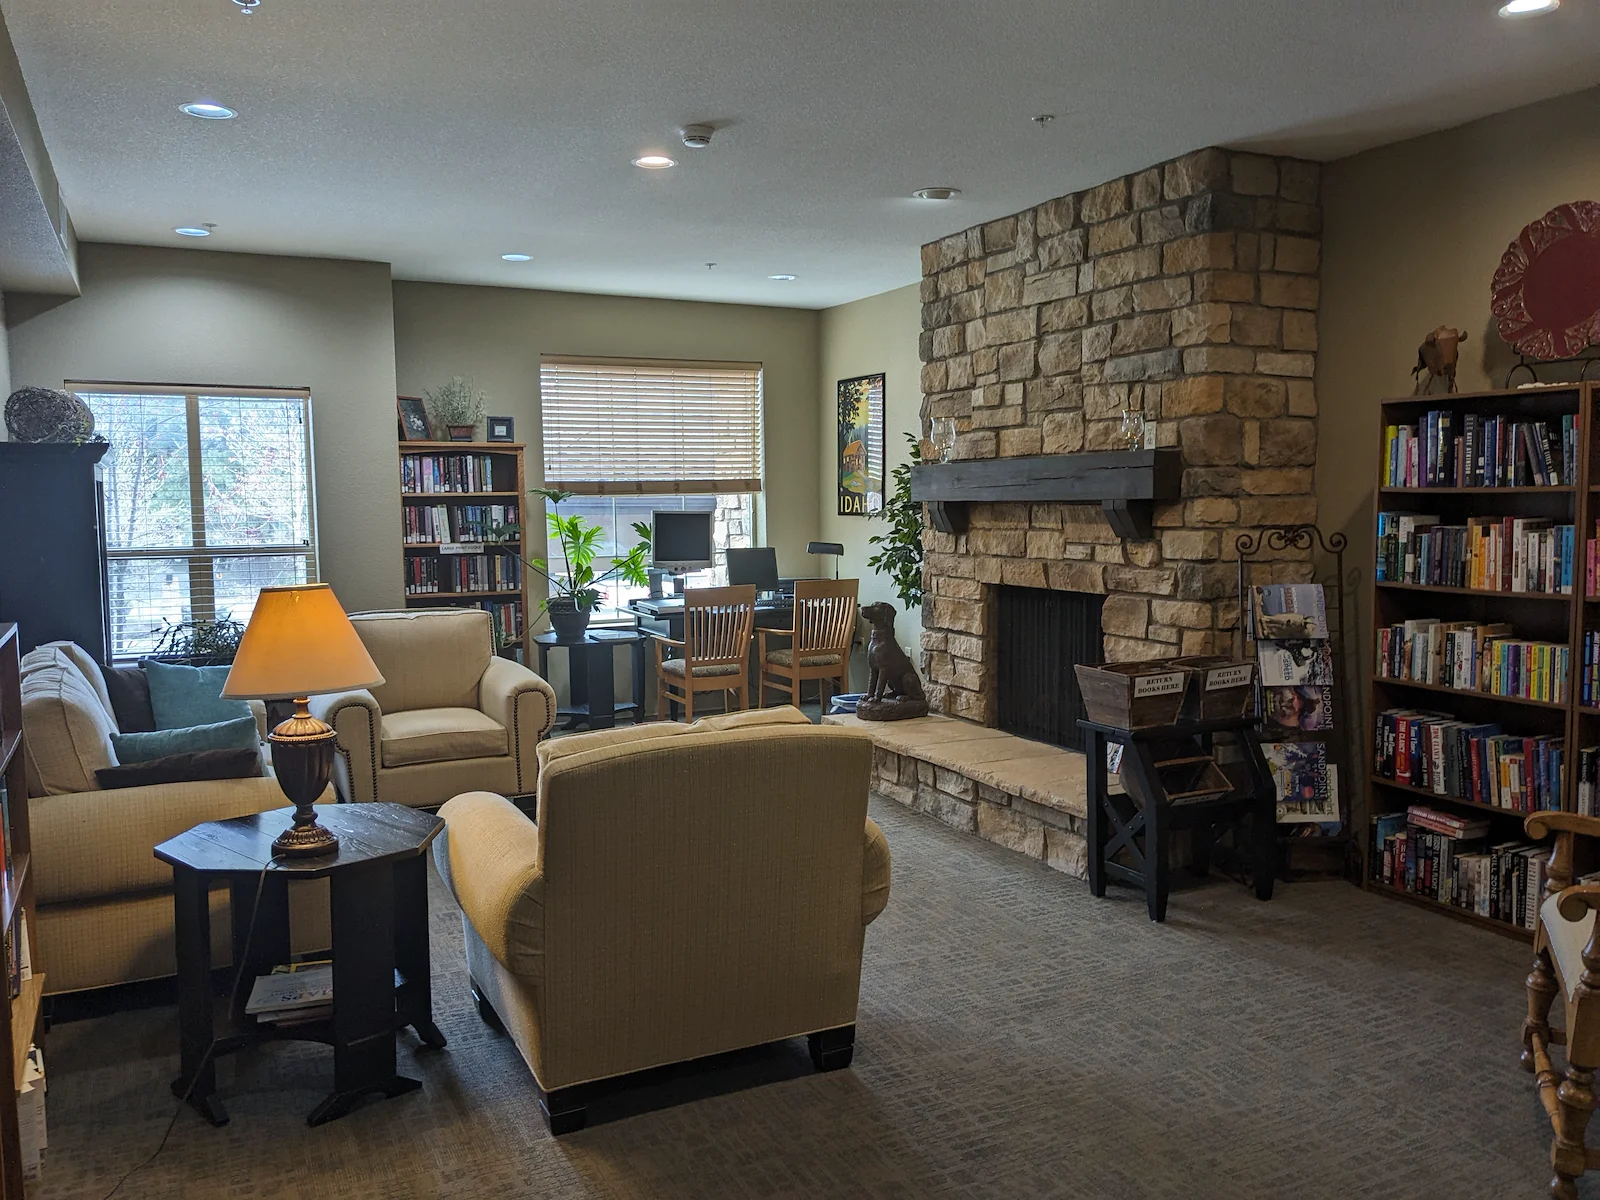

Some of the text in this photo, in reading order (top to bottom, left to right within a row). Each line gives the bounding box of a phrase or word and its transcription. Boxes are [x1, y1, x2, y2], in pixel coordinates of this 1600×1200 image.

[840, 495, 870, 513] IDAH
[1217, 669, 1242, 678] RETURN
[1146, 676, 1173, 685] RETURN
[1208, 675, 1248, 687] BOOKS HERE
[1138, 683, 1180, 694] BOOKS HERE
[1398, 720, 1407, 733] TOM
[1432, 727, 1441, 739] TOM
[1398, 732, 1406, 754] CLANCY
[1316, 742, 1328, 799] SANDPOINT
[1431, 872, 1439, 892] FLIGHT
[1490, 874, 1498, 901] ZONE
